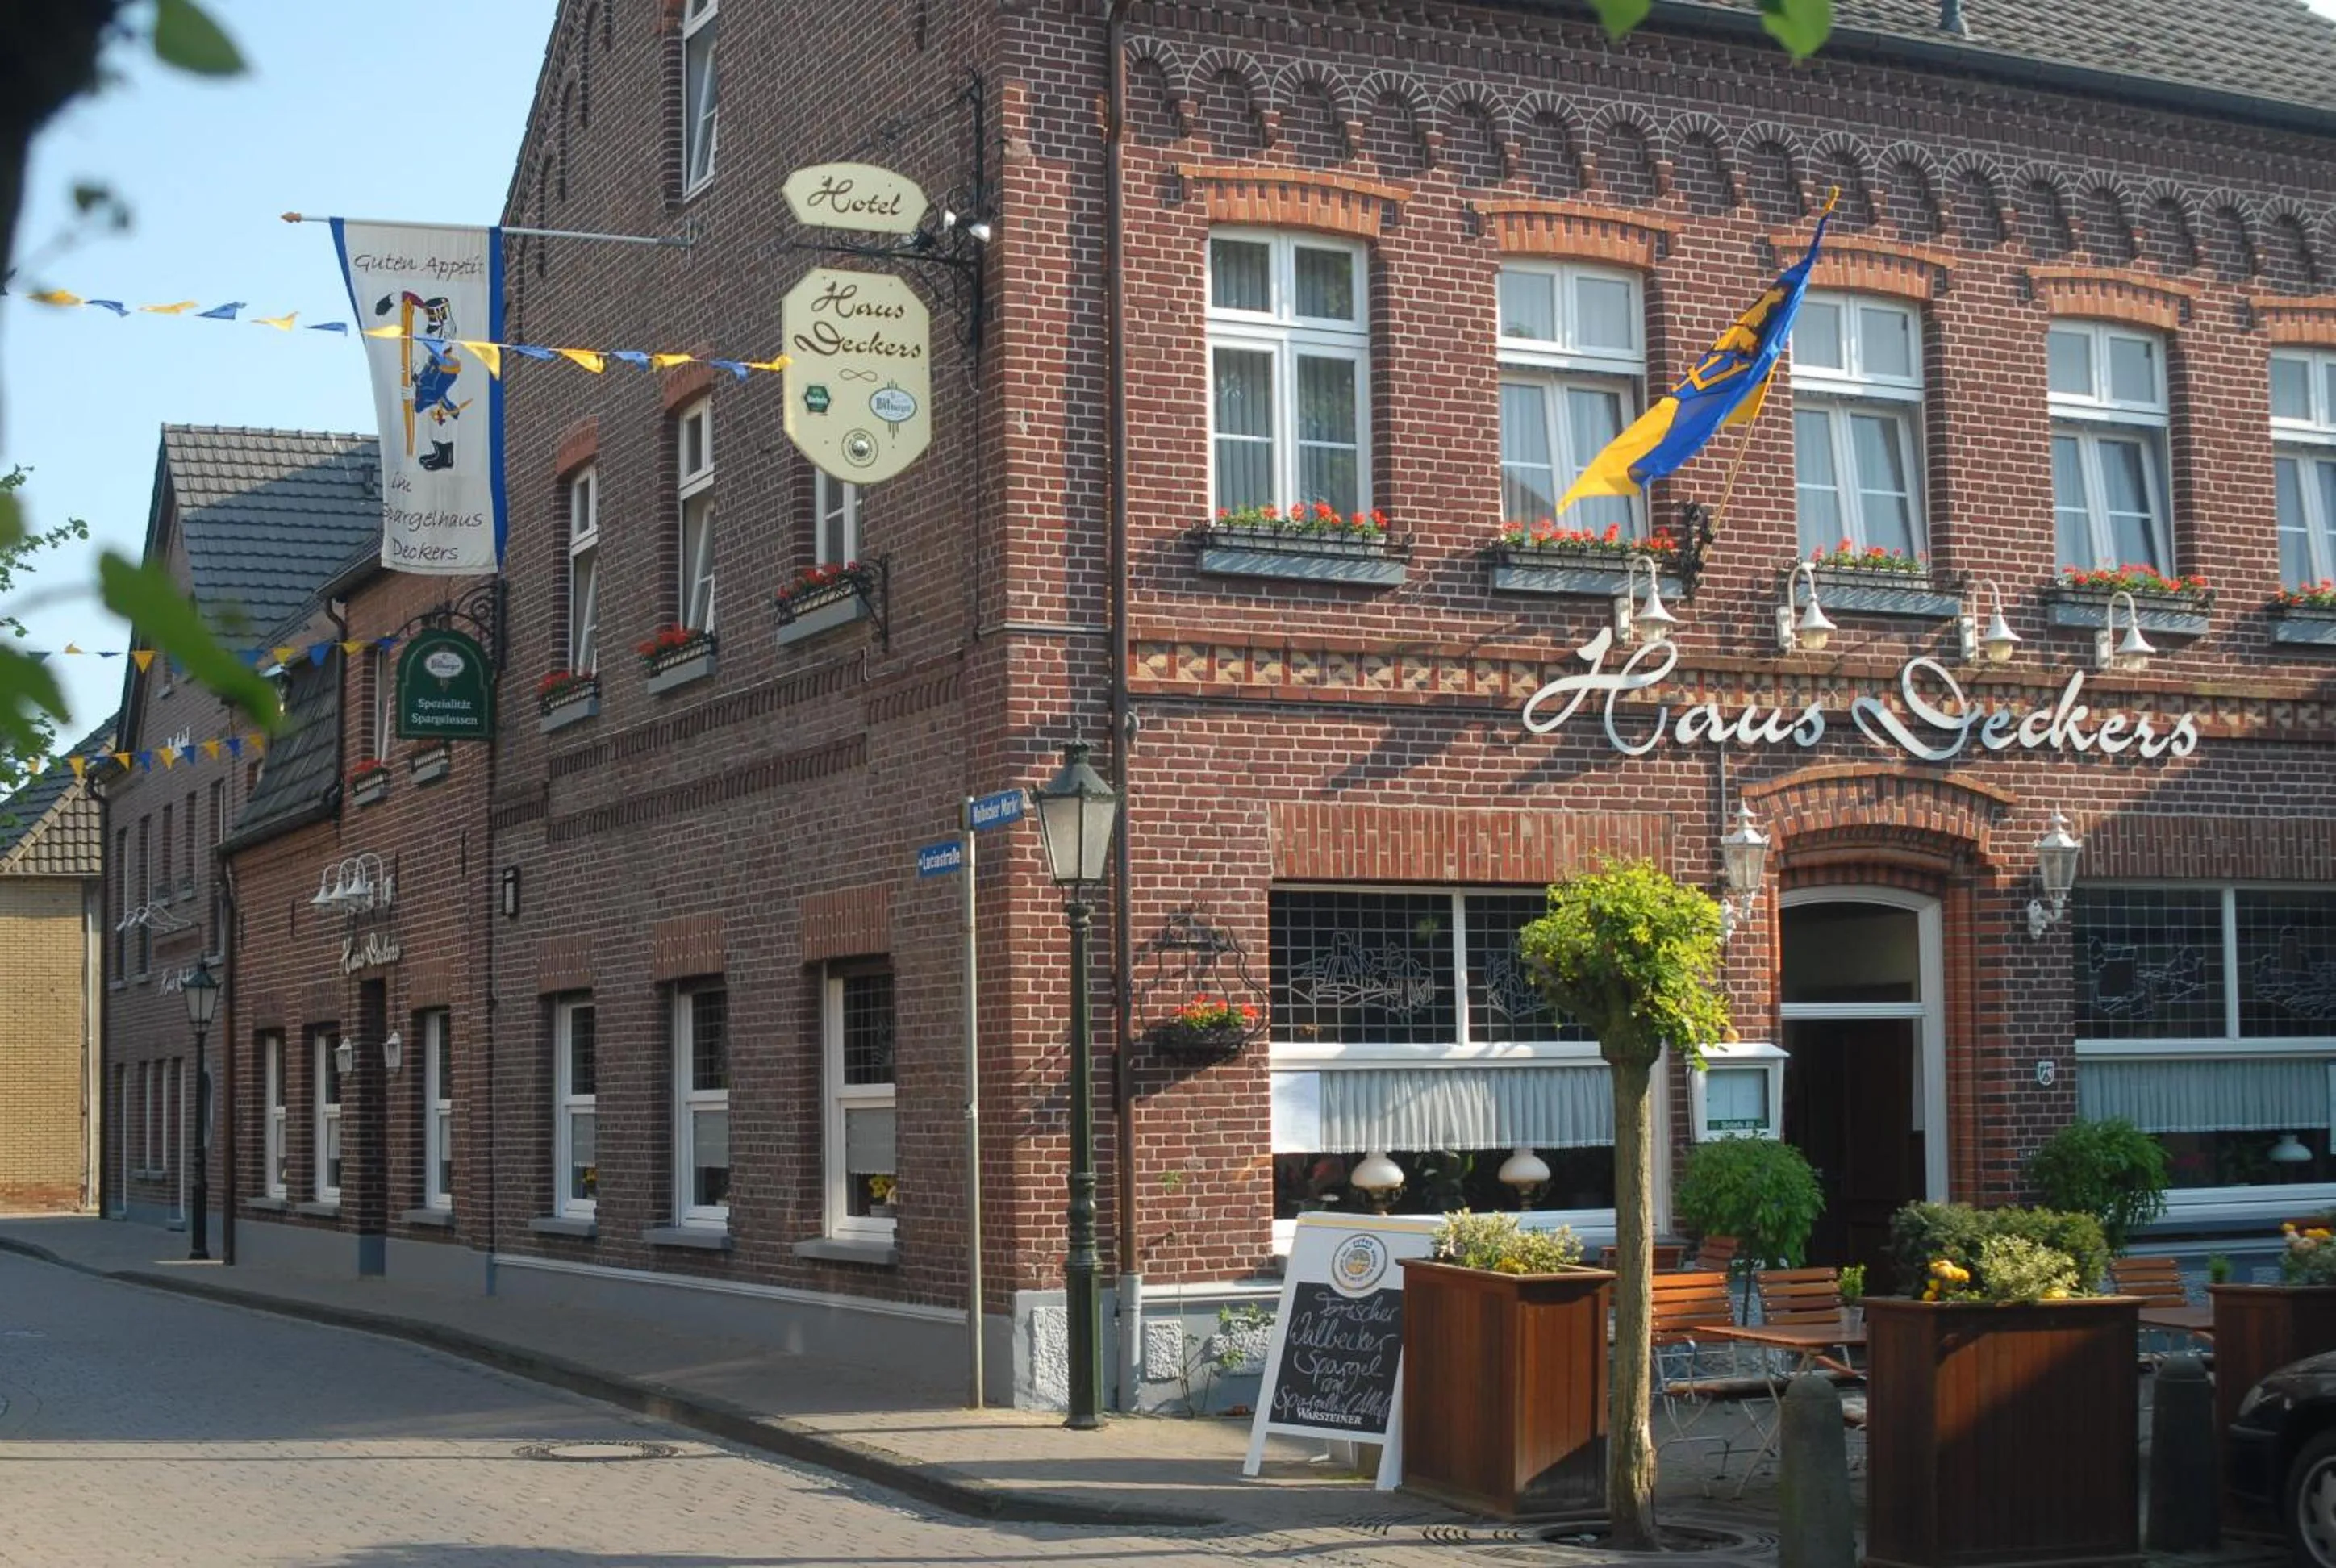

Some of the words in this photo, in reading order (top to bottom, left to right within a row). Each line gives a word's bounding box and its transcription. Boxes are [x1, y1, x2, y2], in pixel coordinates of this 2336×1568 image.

[808, 175, 904, 216] Hotel
[353, 253, 417, 273] Guten
[419, 254, 484, 281] Appetit
[810, 281, 905, 319] Haus
[794, 321, 921, 359] Deckers
[392, 537, 459, 561] Deckers
[418, 699, 472, 710] Spezialität
[1521, 626, 1825, 757] Haus
[1851, 656, 2199, 761] Deckers
[411, 712, 478, 725] Spargelessen
[1314, 1291, 1399, 1322] Frischer
[1289, 1311, 1398, 1353] Walbecker
[1293, 1349, 1384, 1393] Spargel
[1296, 1407, 1362, 1425] WARSTEINER
